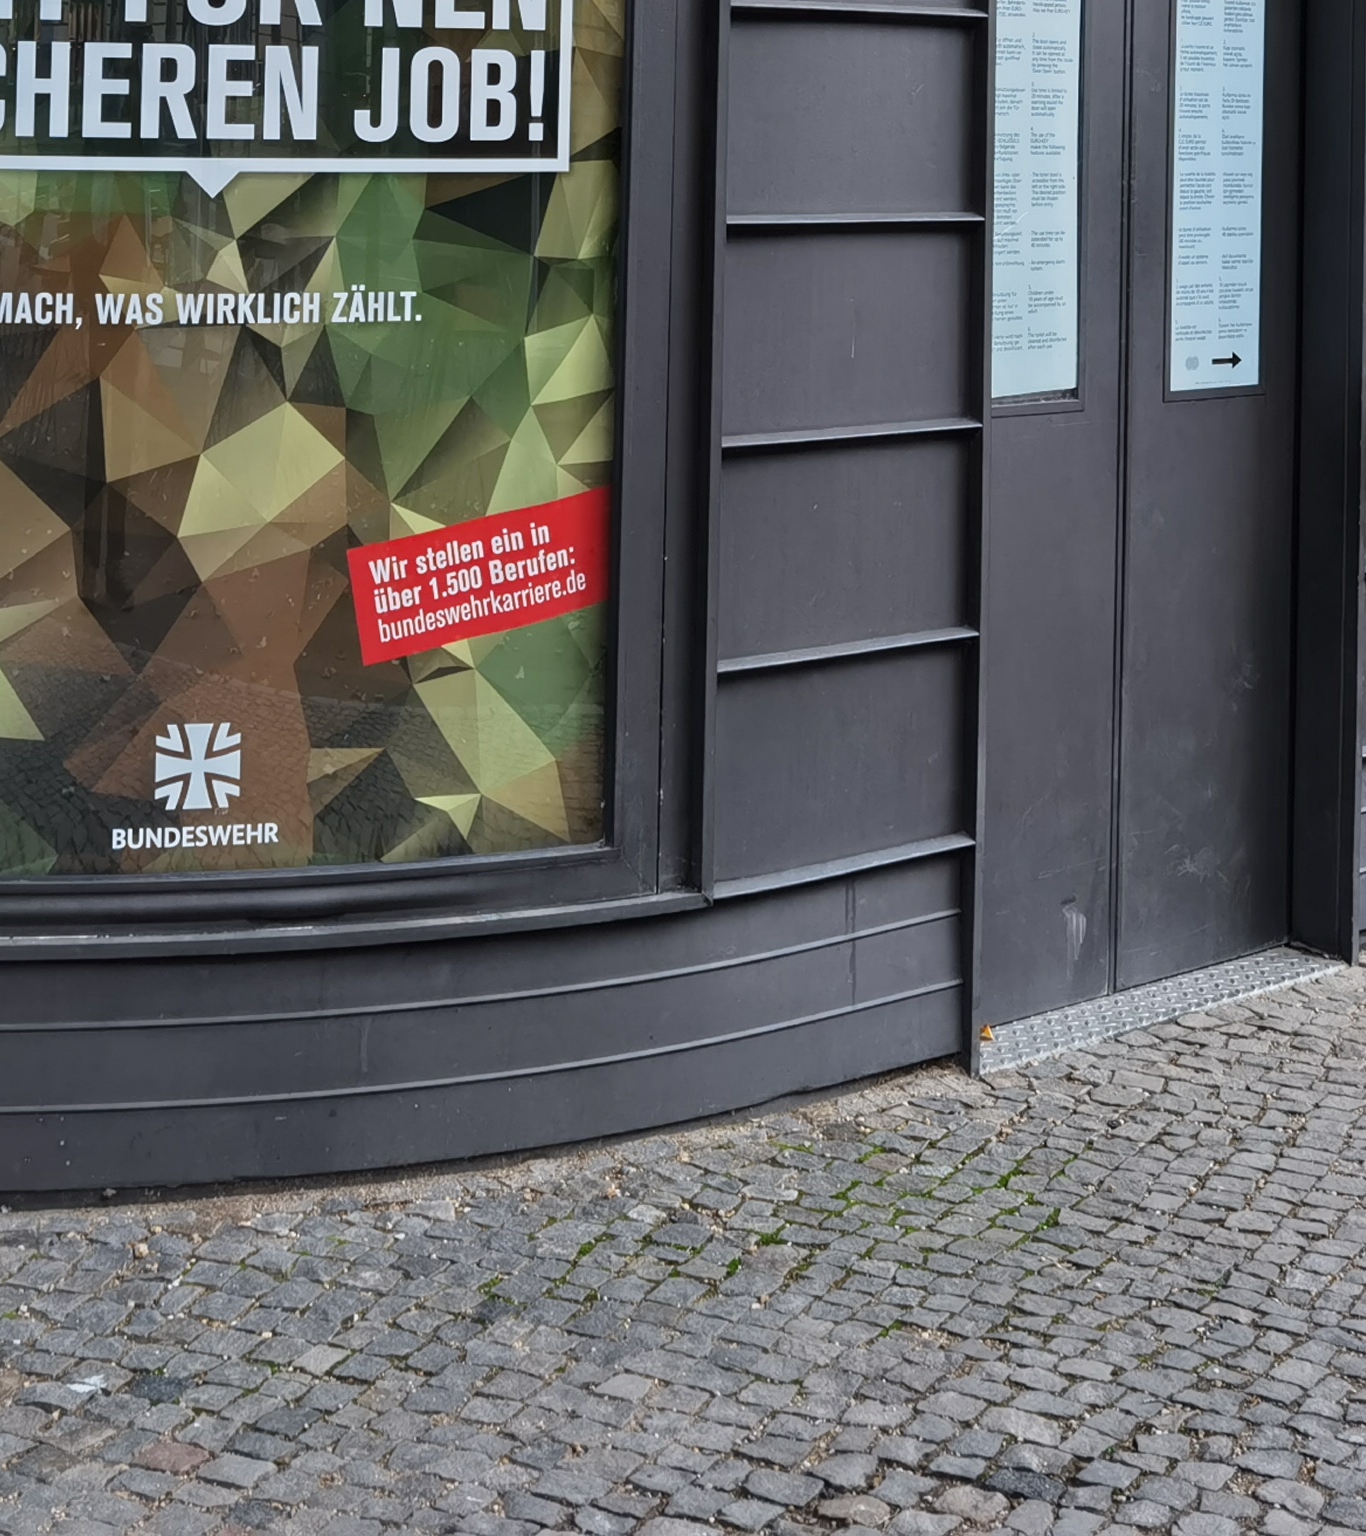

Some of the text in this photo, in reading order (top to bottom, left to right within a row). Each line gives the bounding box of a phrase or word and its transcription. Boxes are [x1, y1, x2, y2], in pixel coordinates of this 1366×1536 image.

[354, 48, 545, 143] JOB!
[95, 294, 163, 324] WAS
[176, 293, 319, 323] WIRKLICH
[332, 286, 422, 322] ZÄHLT.
[369, 523, 550, 584] Wir stellen ein in
[375, 547, 575, 613] über 1.500 Berufen:
[378, 570, 586, 643] bundeswehrkarriere.de
[112, 823, 279, 849] BUNDESWEHR
